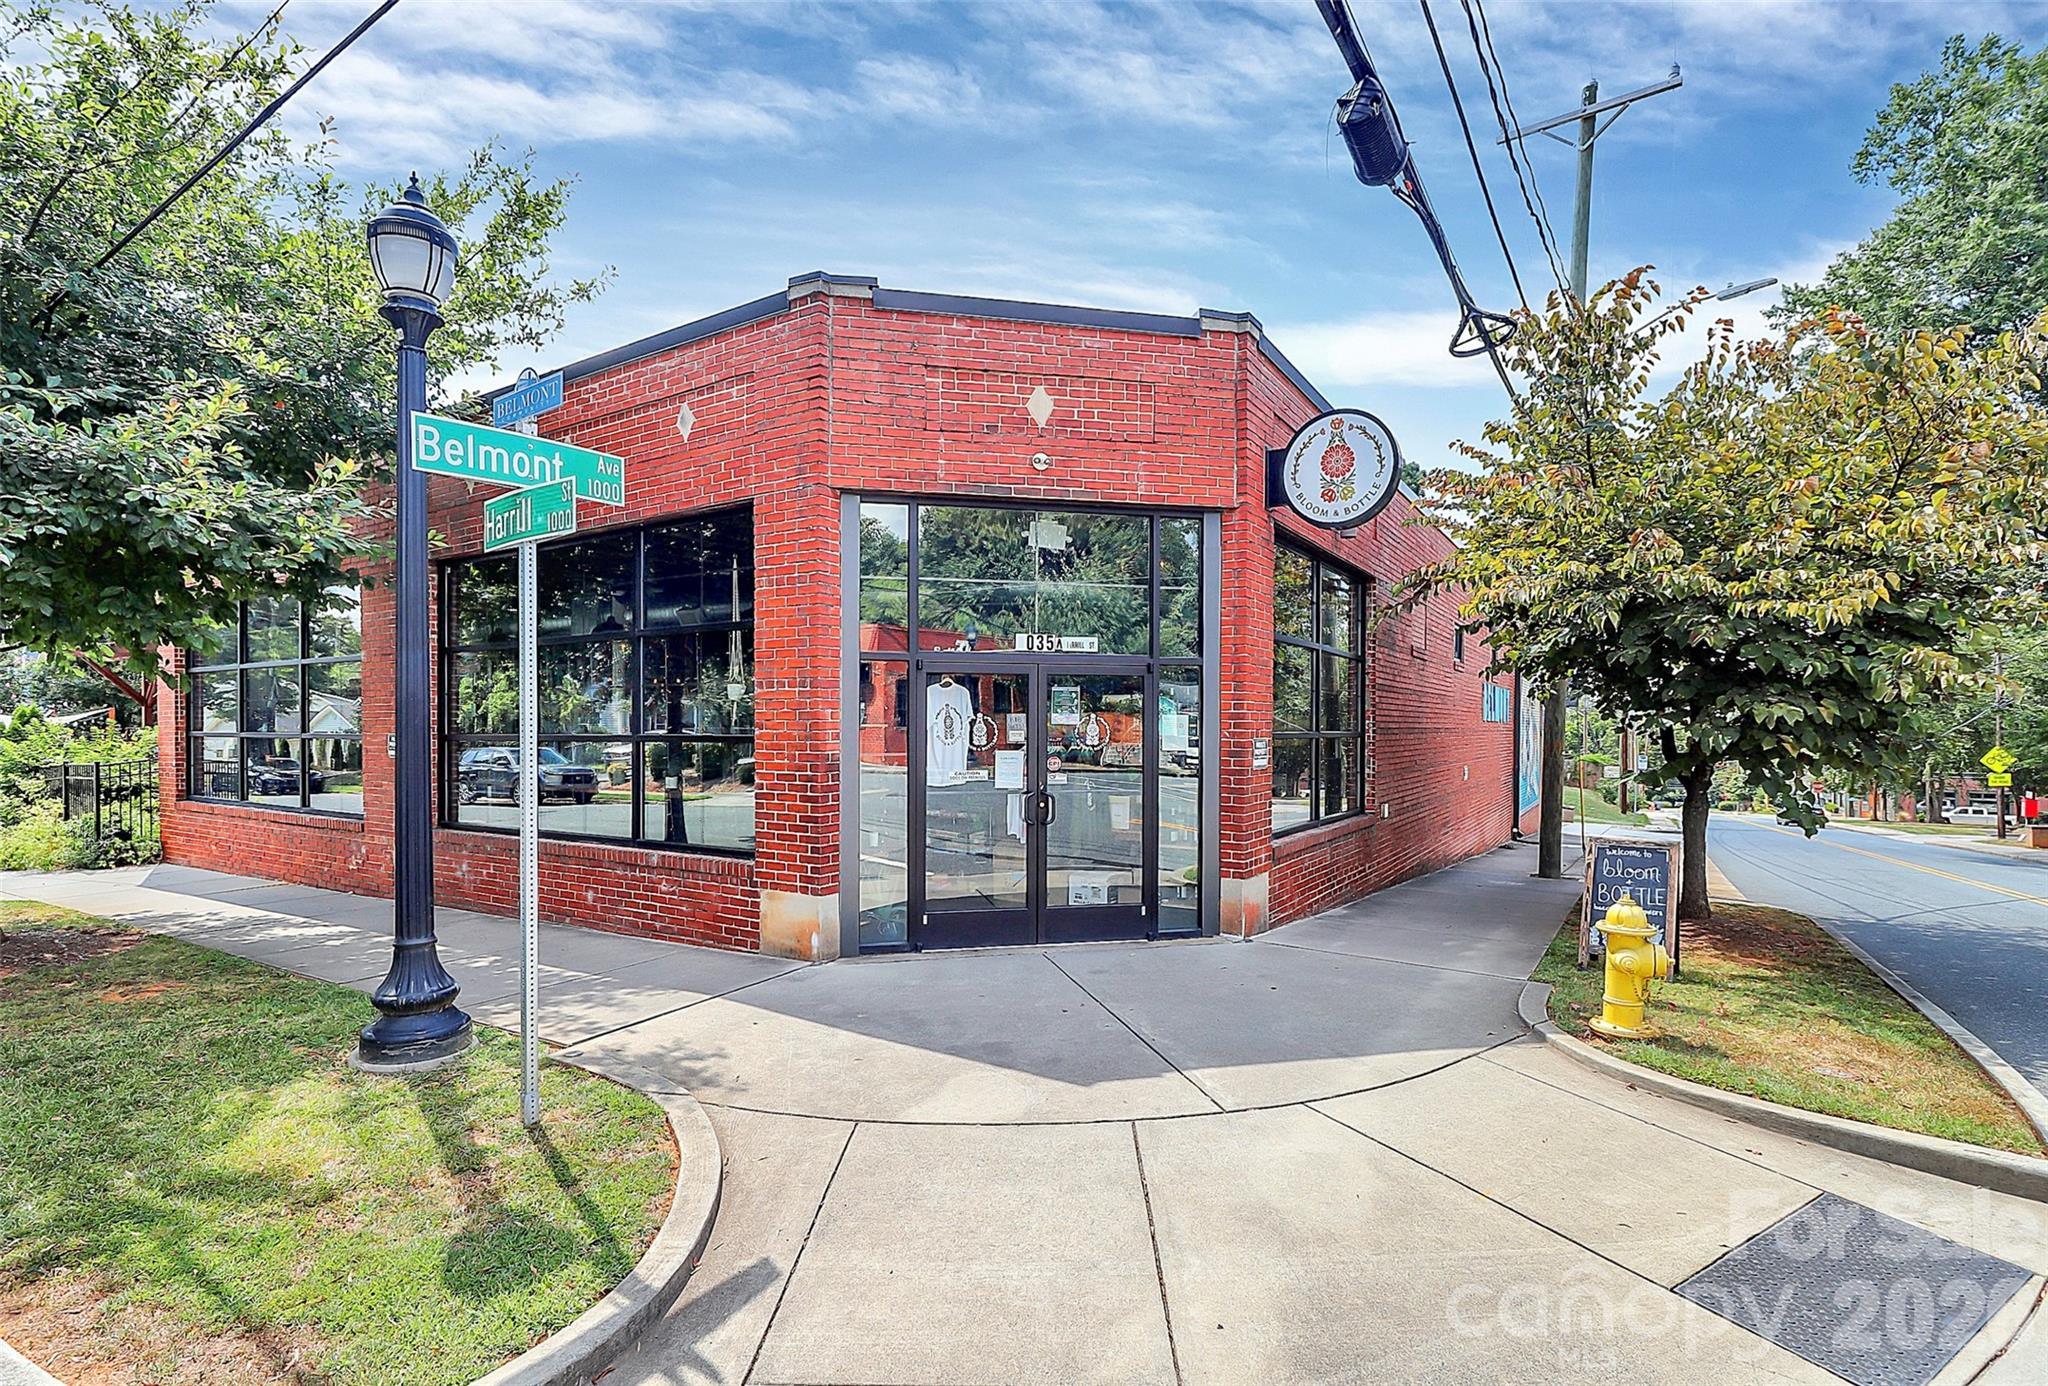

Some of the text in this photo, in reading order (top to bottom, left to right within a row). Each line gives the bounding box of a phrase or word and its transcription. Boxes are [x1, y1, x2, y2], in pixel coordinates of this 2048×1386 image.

[497, 381, 559, 419] BELMONT
[418, 424, 620, 482] Belmont Ave
[561, 481, 572, 502] St
[587, 479, 620, 501] 1000
[1295, 493, 1329, 517] BLOOM
[1343, 481, 1382, 516] BOTTLE
[486, 496, 572, 542] Harrill 1000
[1605, 848, 1653, 858] welcome to
[1603, 858, 1661, 882] bloom
